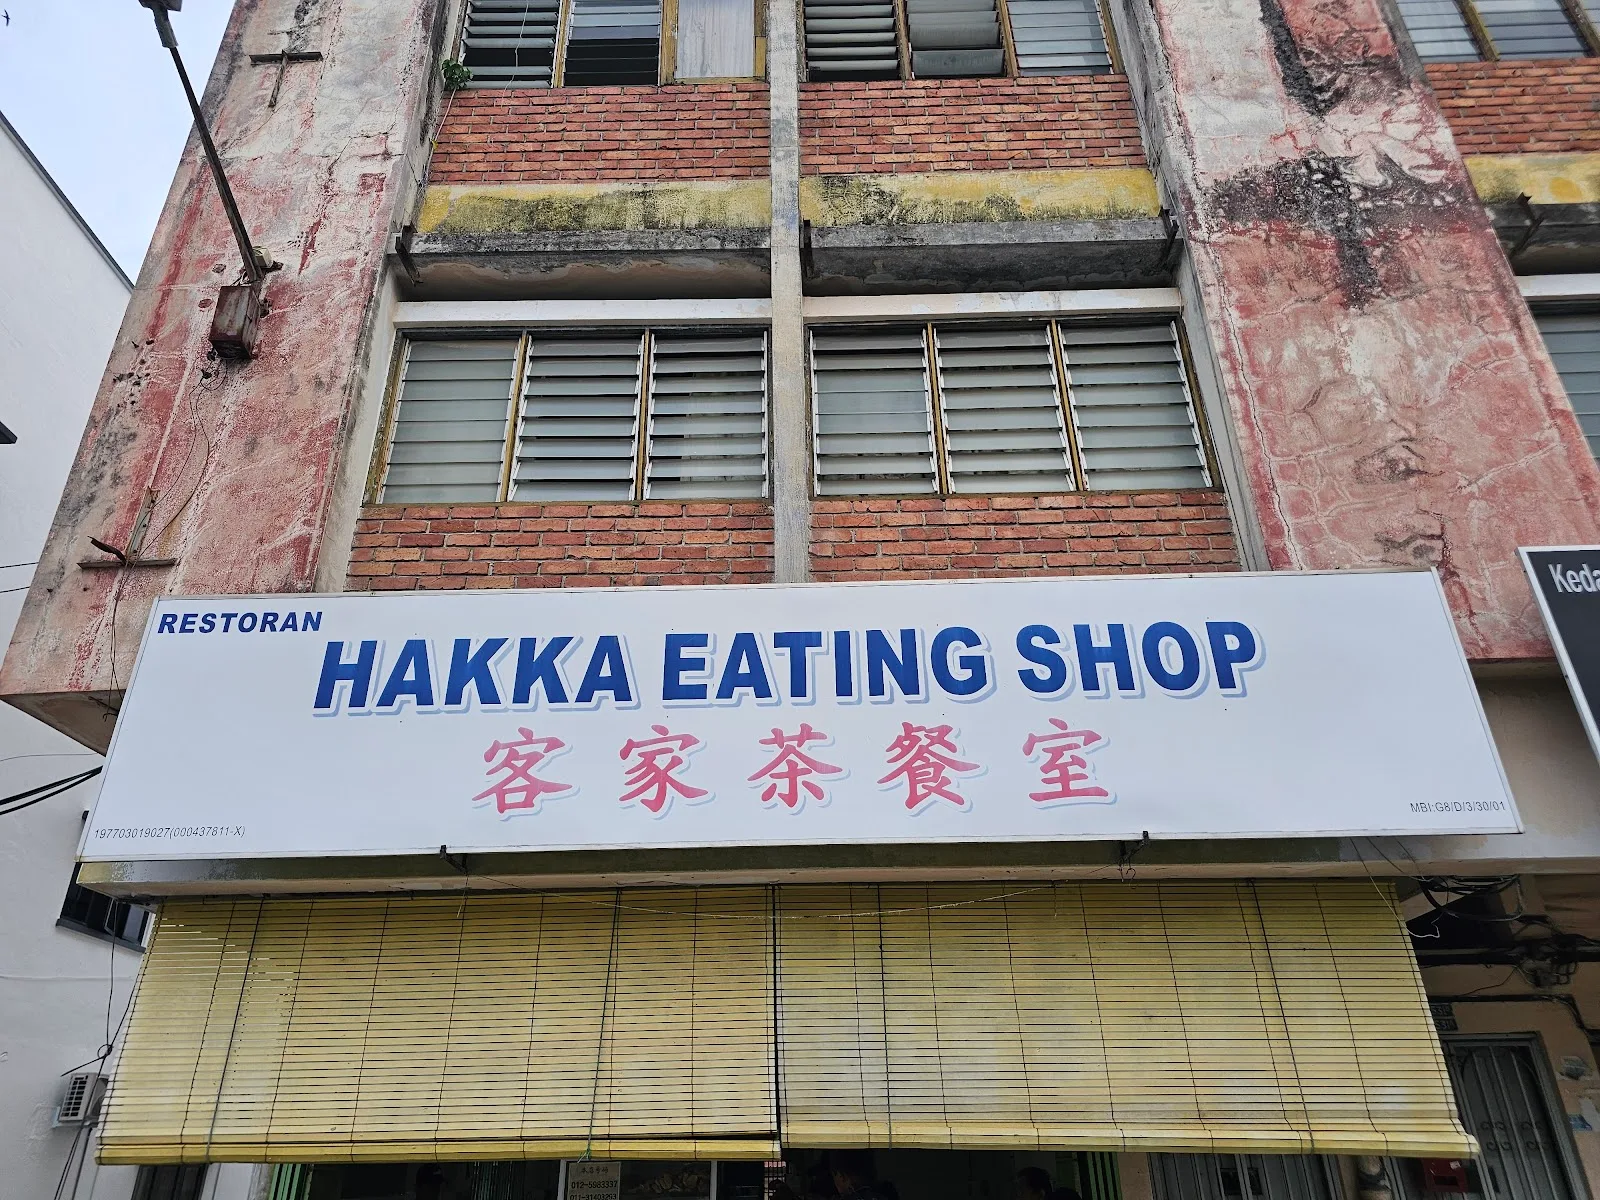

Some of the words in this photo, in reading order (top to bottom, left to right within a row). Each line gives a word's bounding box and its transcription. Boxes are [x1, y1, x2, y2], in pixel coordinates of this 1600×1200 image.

[157, 611, 322, 634] RESTORAN
[312, 629, 634, 711] HAKKA
[662, 625, 990, 703] EATING
[1016, 621, 1259, 696] SHOP
[472, 717, 1110, 815] 客家茶餐室
[94, 826, 246, 840] 197703019027(000437811-X)
